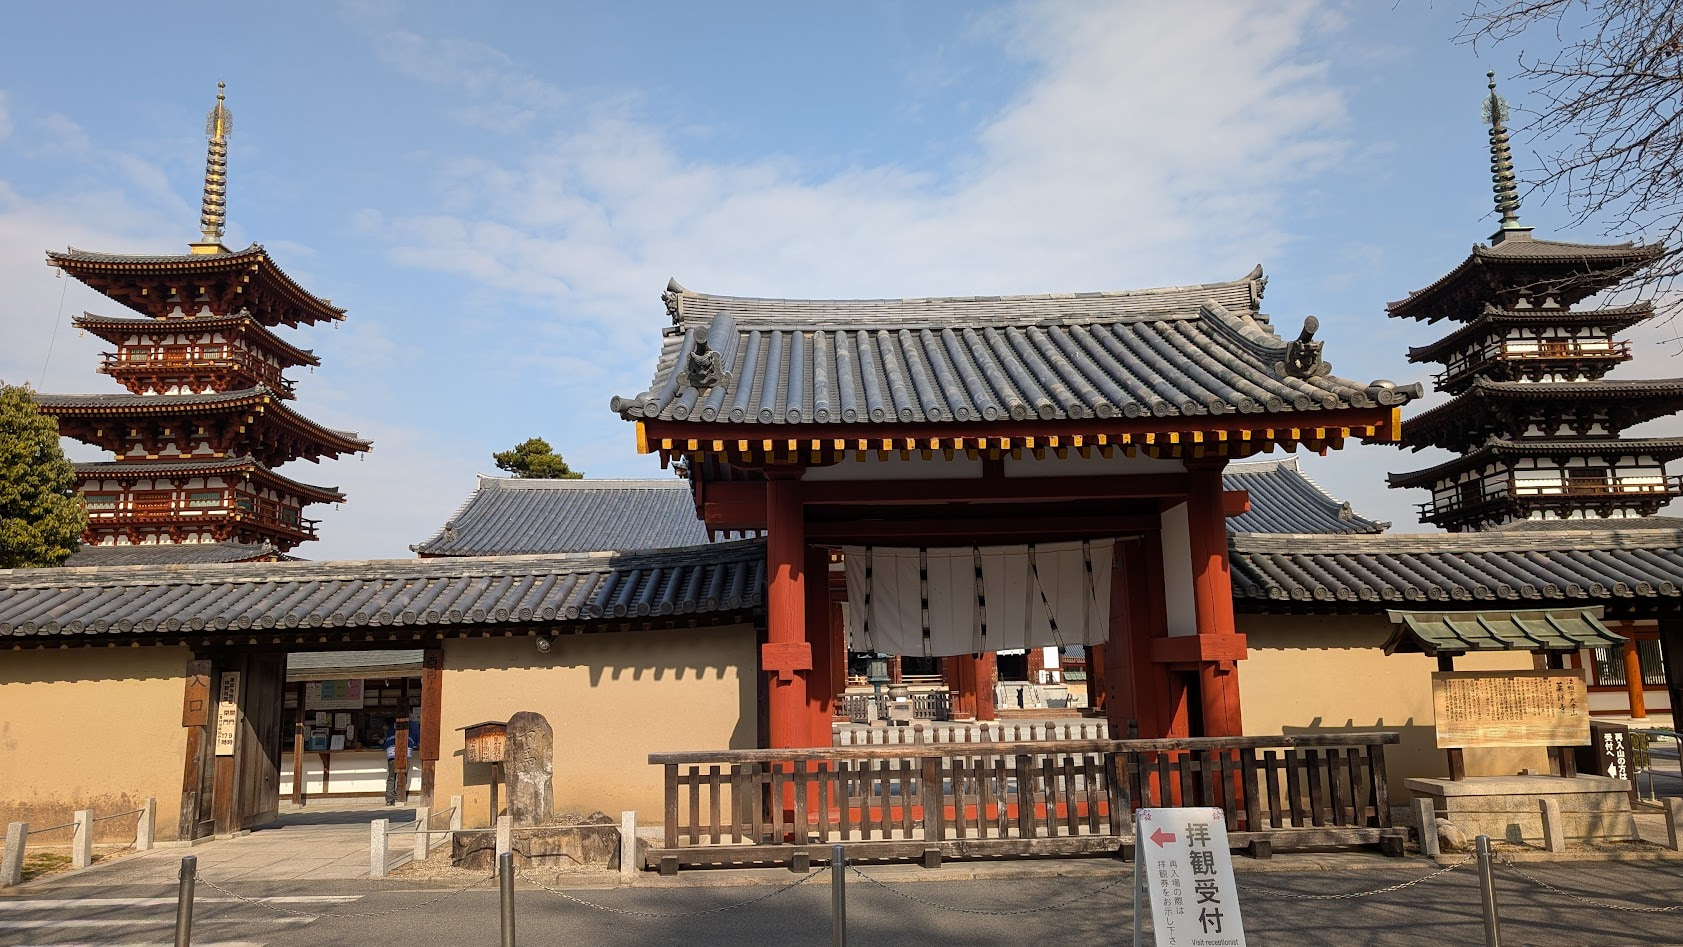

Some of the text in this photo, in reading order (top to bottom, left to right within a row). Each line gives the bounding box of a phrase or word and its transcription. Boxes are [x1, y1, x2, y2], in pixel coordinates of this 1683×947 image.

[190, 675, 206, 712] 入口
[1556, 681, 1566, 714] 薬師寺
[1603, 733, 1615, 757] 受付へ
[1614, 732, 1628, 780] 再入山の方は
[1169, 860, 1184, 915] 再入場の際は
[1185, 822, 1224, 934] 拝観受付
[1158, 861, 1177, 947] 拝観券をお示し下さ
